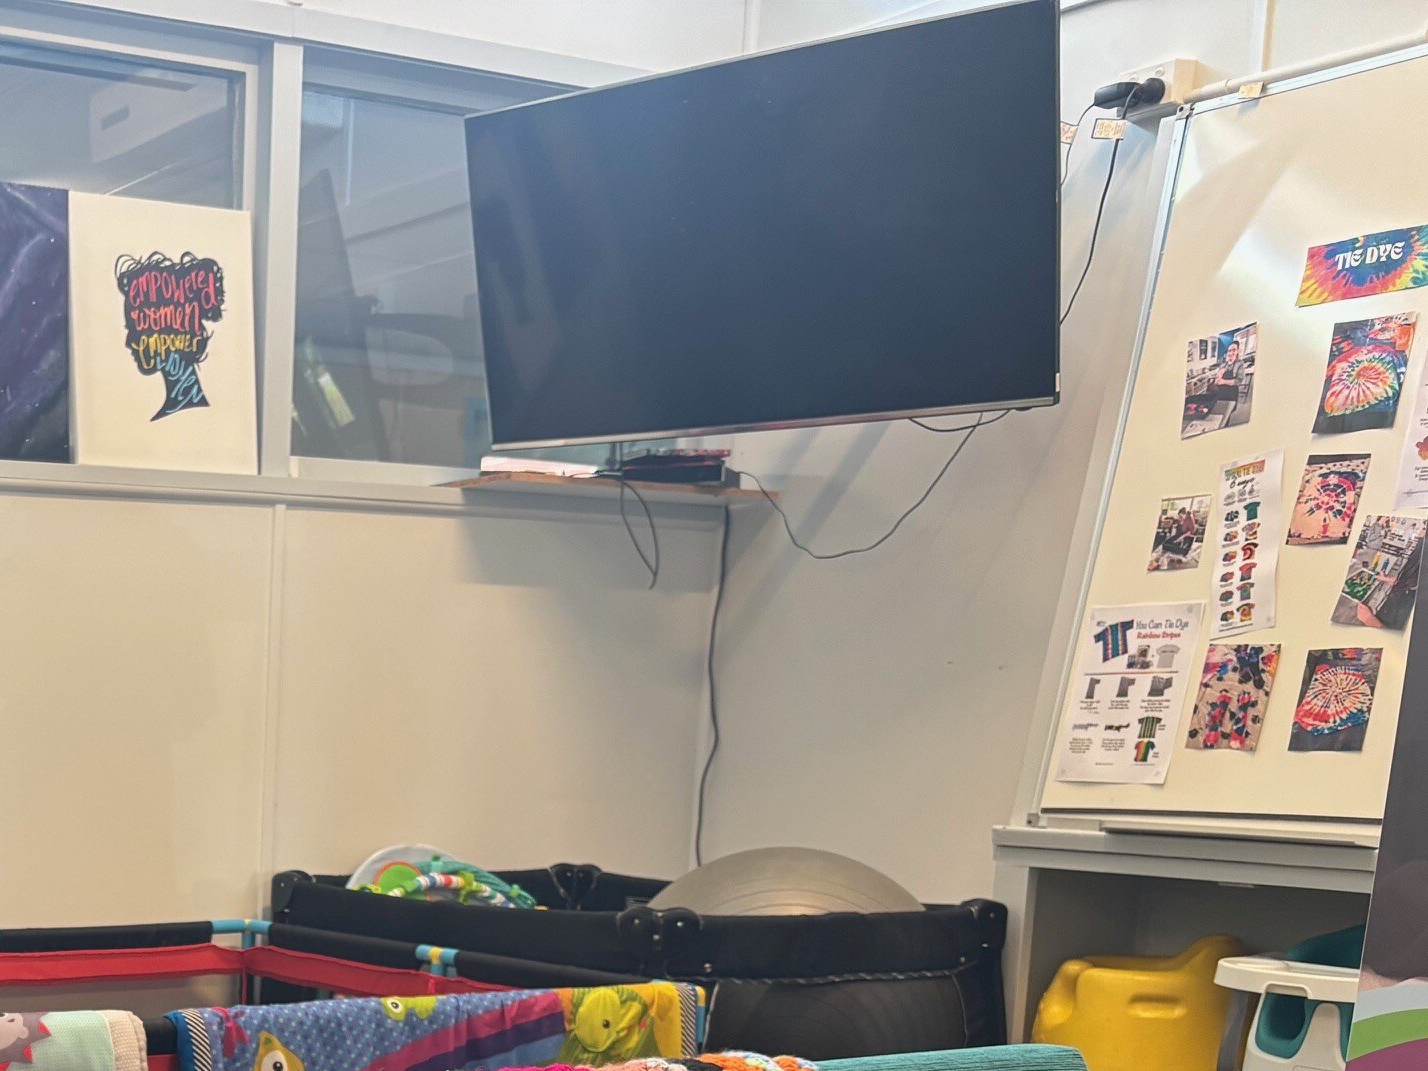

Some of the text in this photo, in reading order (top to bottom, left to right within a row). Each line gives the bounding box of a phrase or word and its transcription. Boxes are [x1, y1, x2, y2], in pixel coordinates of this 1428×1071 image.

[1335, 241, 1405, 270] TIE DYE
[1148, 620, 1162, 629] Can
